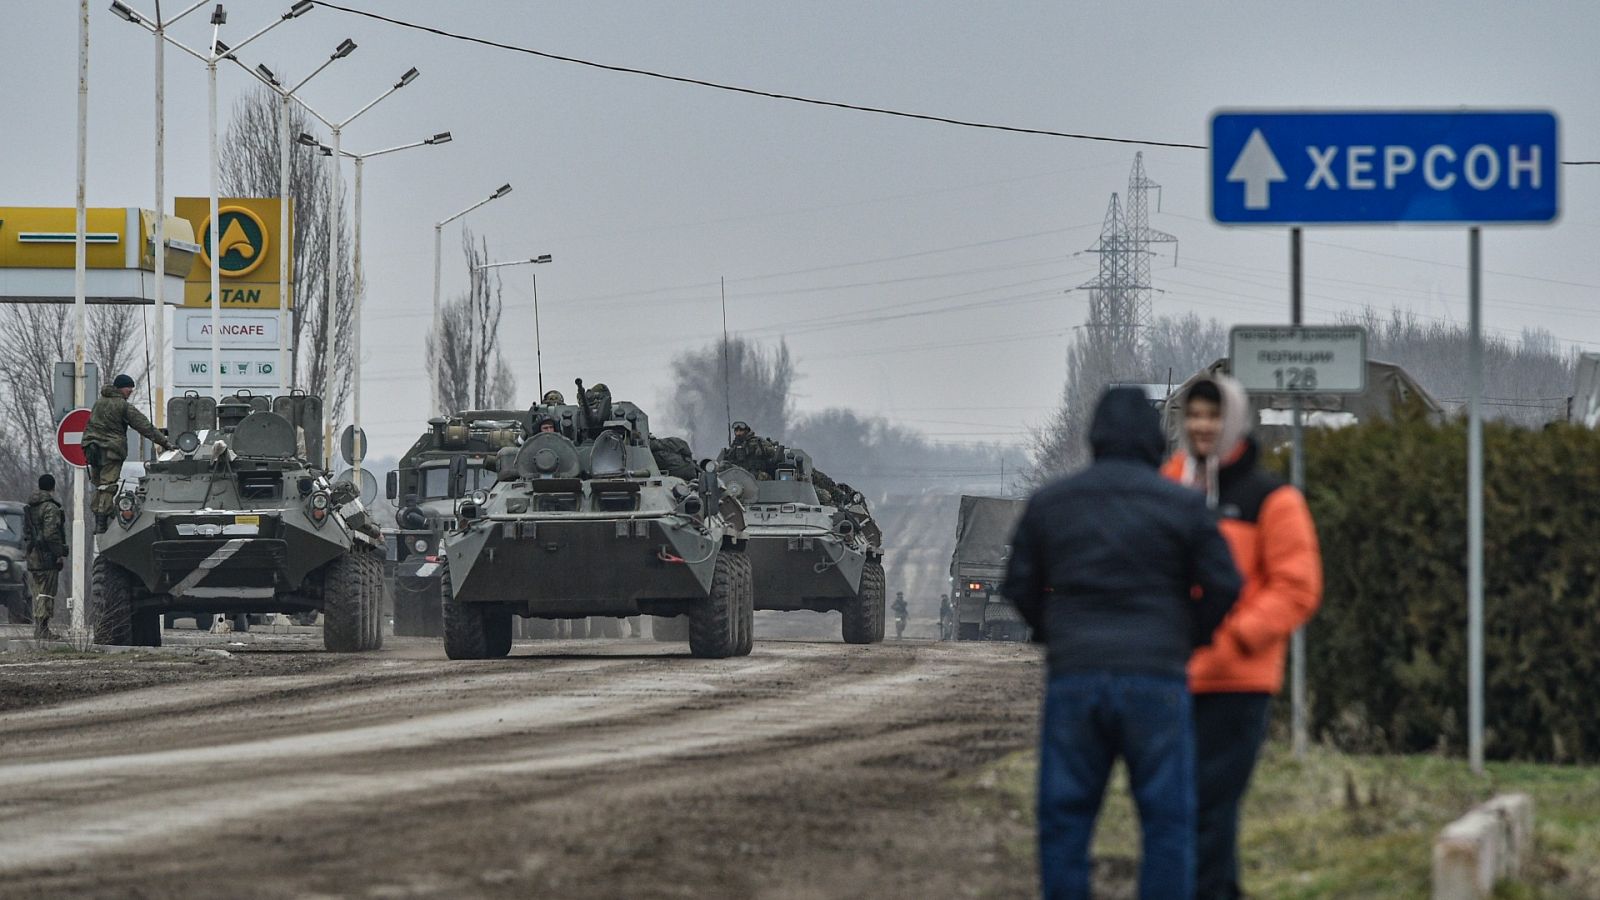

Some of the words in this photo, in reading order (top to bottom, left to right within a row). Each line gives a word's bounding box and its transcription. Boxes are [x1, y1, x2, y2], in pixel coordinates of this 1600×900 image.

[1305, 144, 1542, 191] ХЕРСОН
[190, 363, 207, 374] WC
[1273, 366, 1318, 390] 128
